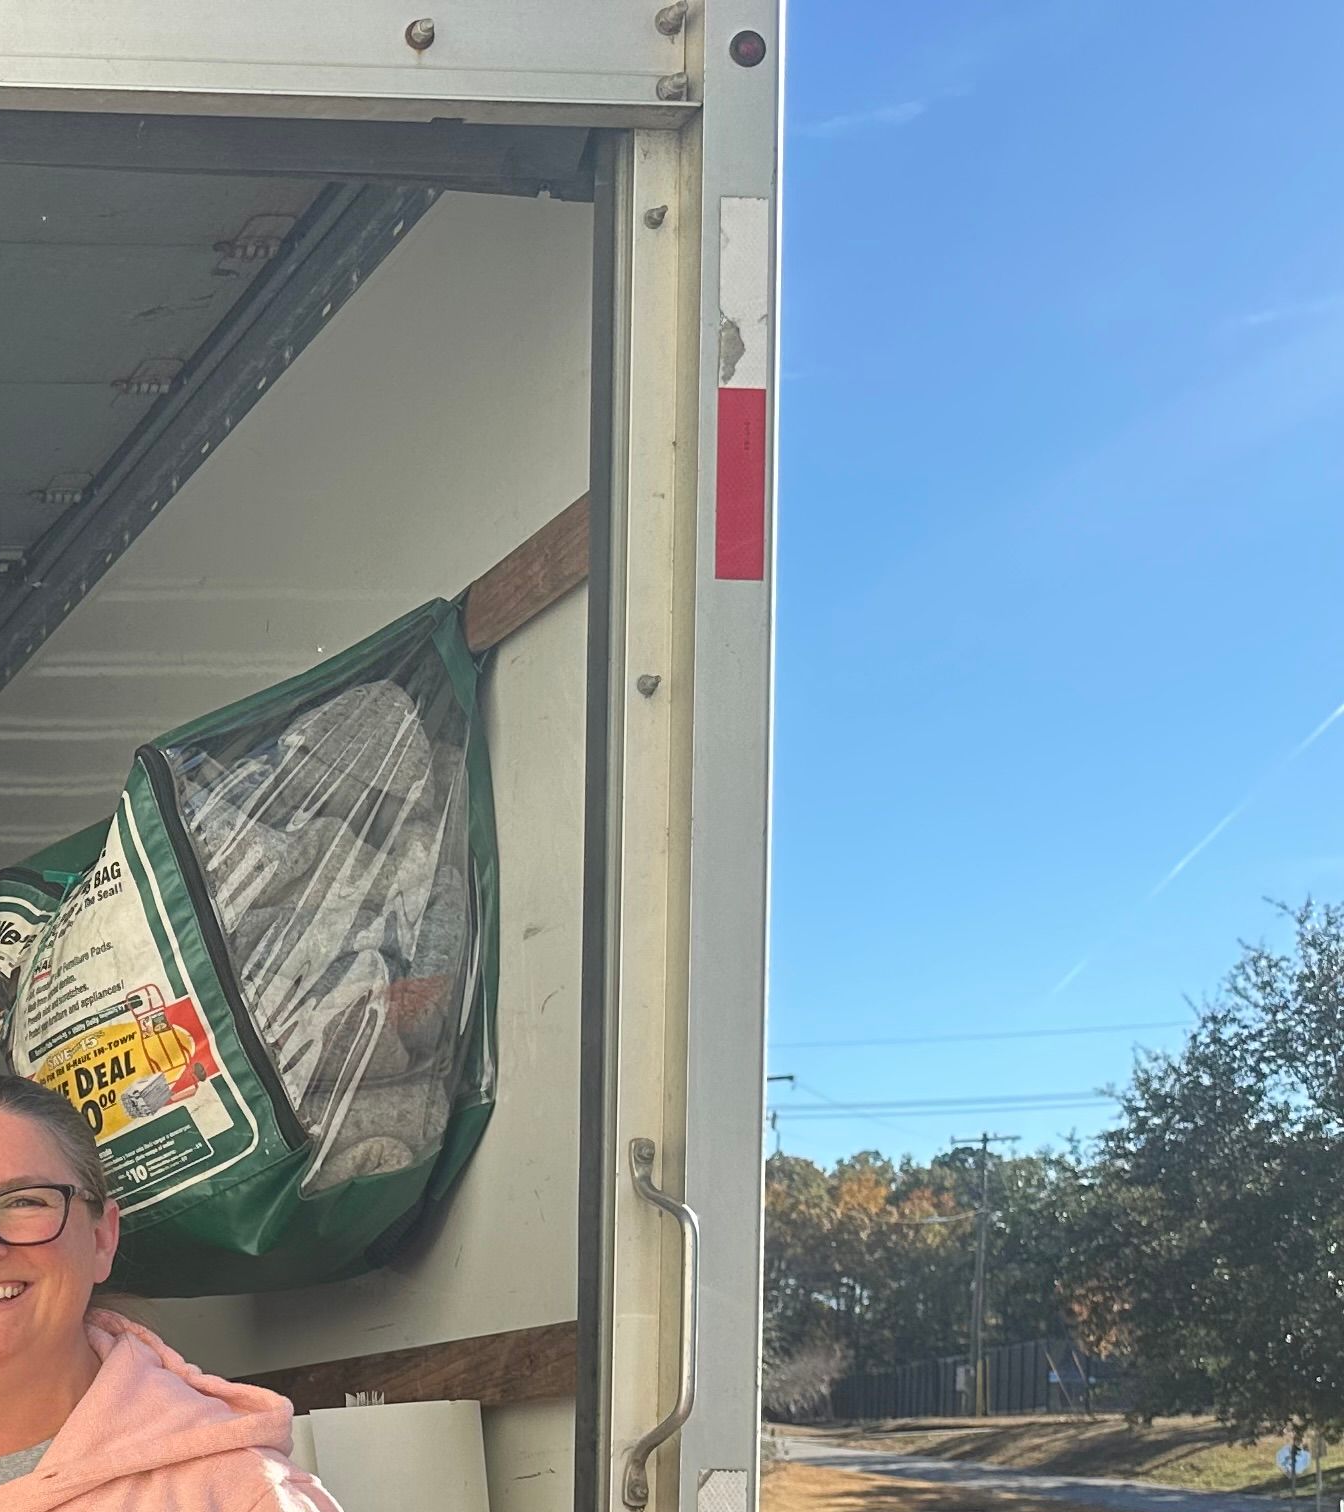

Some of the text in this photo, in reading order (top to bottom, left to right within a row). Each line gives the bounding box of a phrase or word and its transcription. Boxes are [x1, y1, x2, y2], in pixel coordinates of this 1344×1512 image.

[93, 861, 122, 890] BAG
[97, 882, 123, 902] Seal!
[90, 940, 114, 958] Pads.
[80, 979, 125, 1008] appliances!
[93, 1031, 138, 1058] IN-TOWN
[74, 1049, 136, 1100] DEAL
